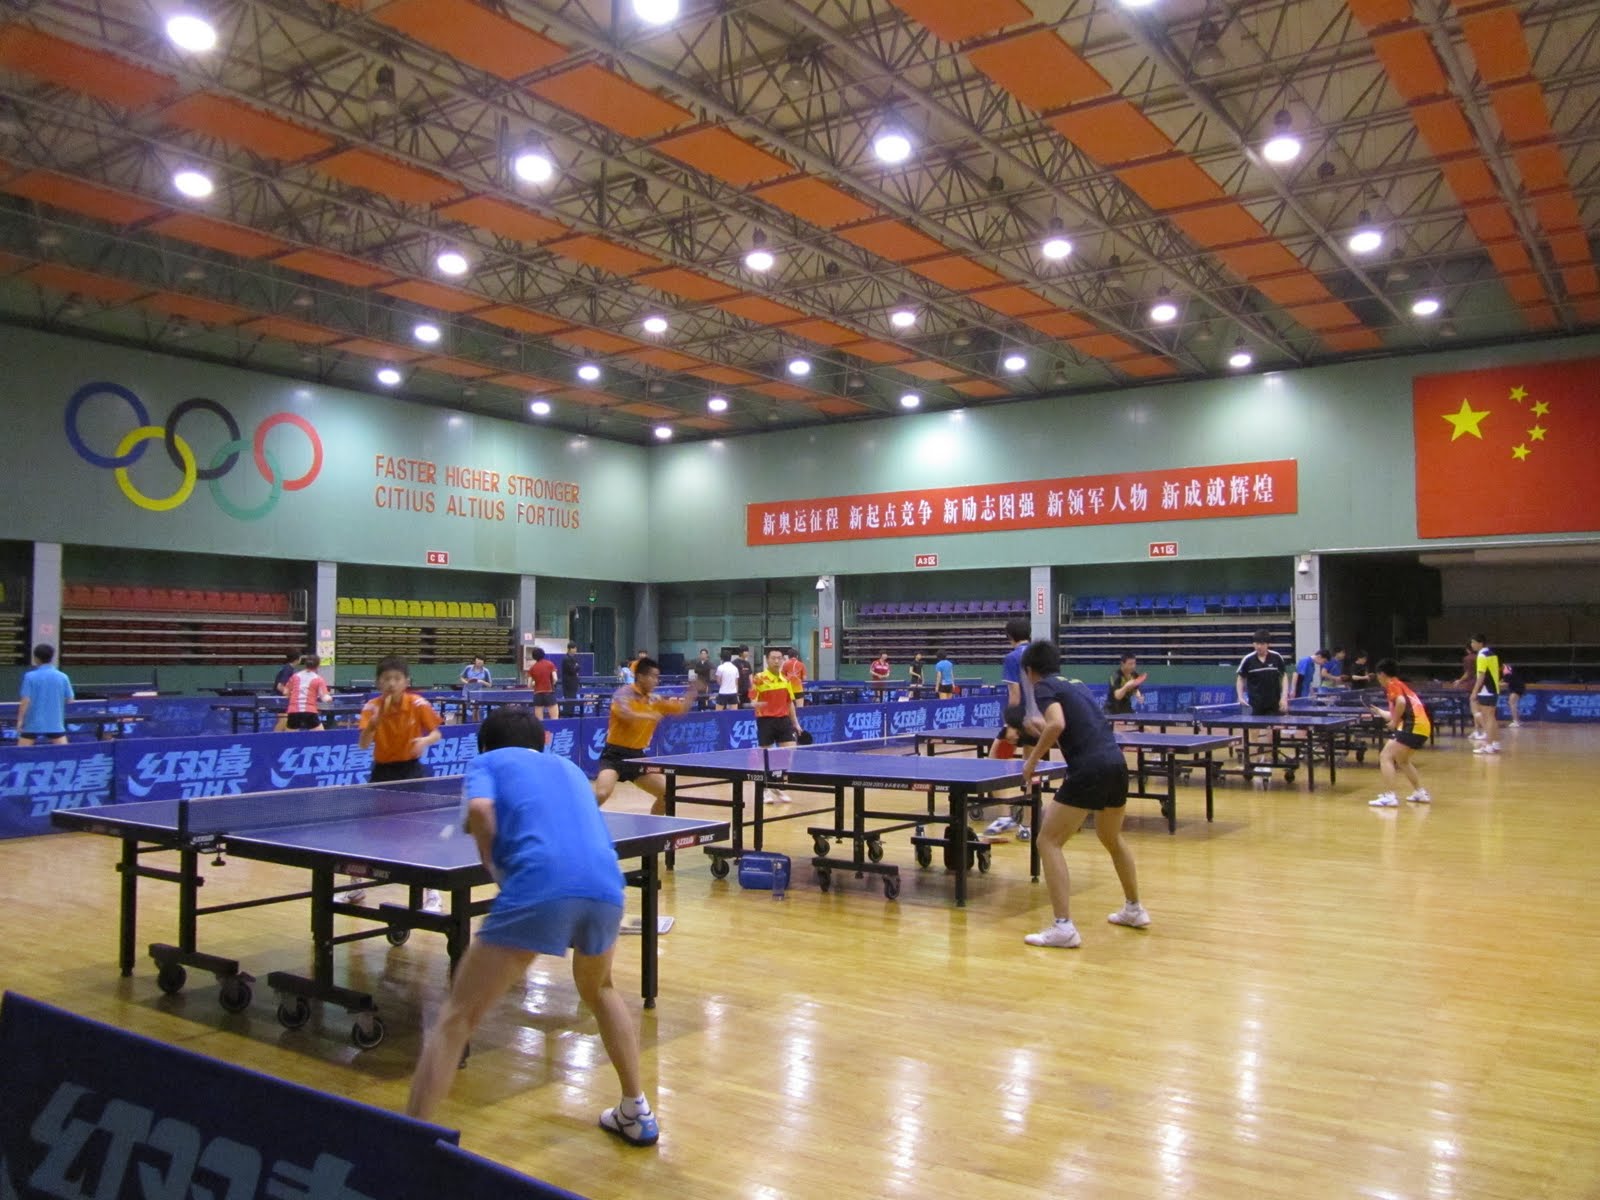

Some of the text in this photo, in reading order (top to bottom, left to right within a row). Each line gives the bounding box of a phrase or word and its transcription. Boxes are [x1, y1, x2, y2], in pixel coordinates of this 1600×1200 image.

[375, 454, 580, 504] FASTER HIGHER STRONGER
[375, 486, 580, 529] CITIUS ALTIUS FORTIUS
[762, 473, 1274, 536] 新奥运征程 新起点竞争 新励志图强 新领军人物 新成就辉煌
[847, 709, 882, 730] 红双喜
[893, 707, 927, 728] 红双喜
[0, 753, 115, 797] 红双喜
[136, 743, 253, 784] 红双喜
[277, 741, 375, 774] 红双喜
[180, 778, 249, 801] DHS
